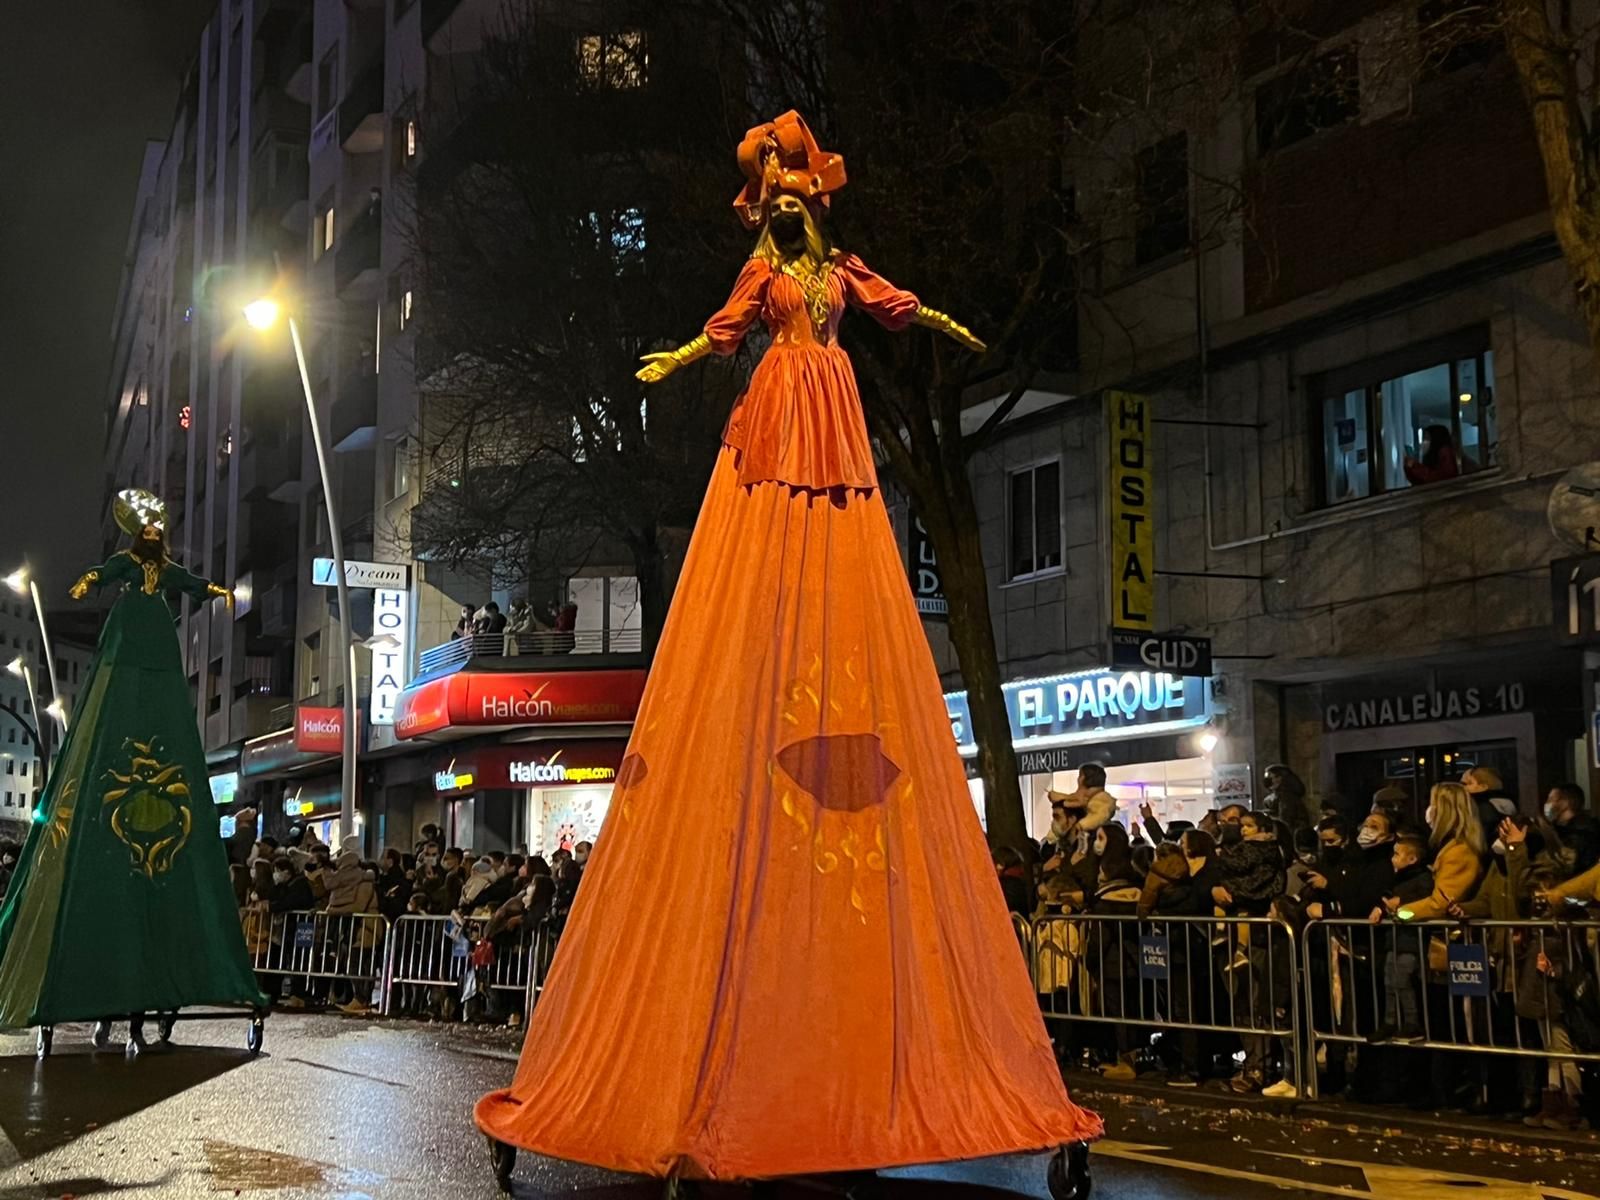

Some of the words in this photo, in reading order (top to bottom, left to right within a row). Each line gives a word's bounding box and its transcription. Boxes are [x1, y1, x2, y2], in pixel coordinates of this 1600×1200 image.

[1119, 399, 1147, 622] HOSTAL
[346, 565, 400, 580] Dream
[378, 593, 402, 709] HOTAL
[1141, 639, 1197, 668] GUD
[1018, 688, 1053, 727] EL
[1057, 671, 1184, 722] PARQUE
[1326, 687, 1481, 730] CANALEJAS
[1496, 683, 1524, 712] 10
[1021, 751, 1069, 771] PARQUE
